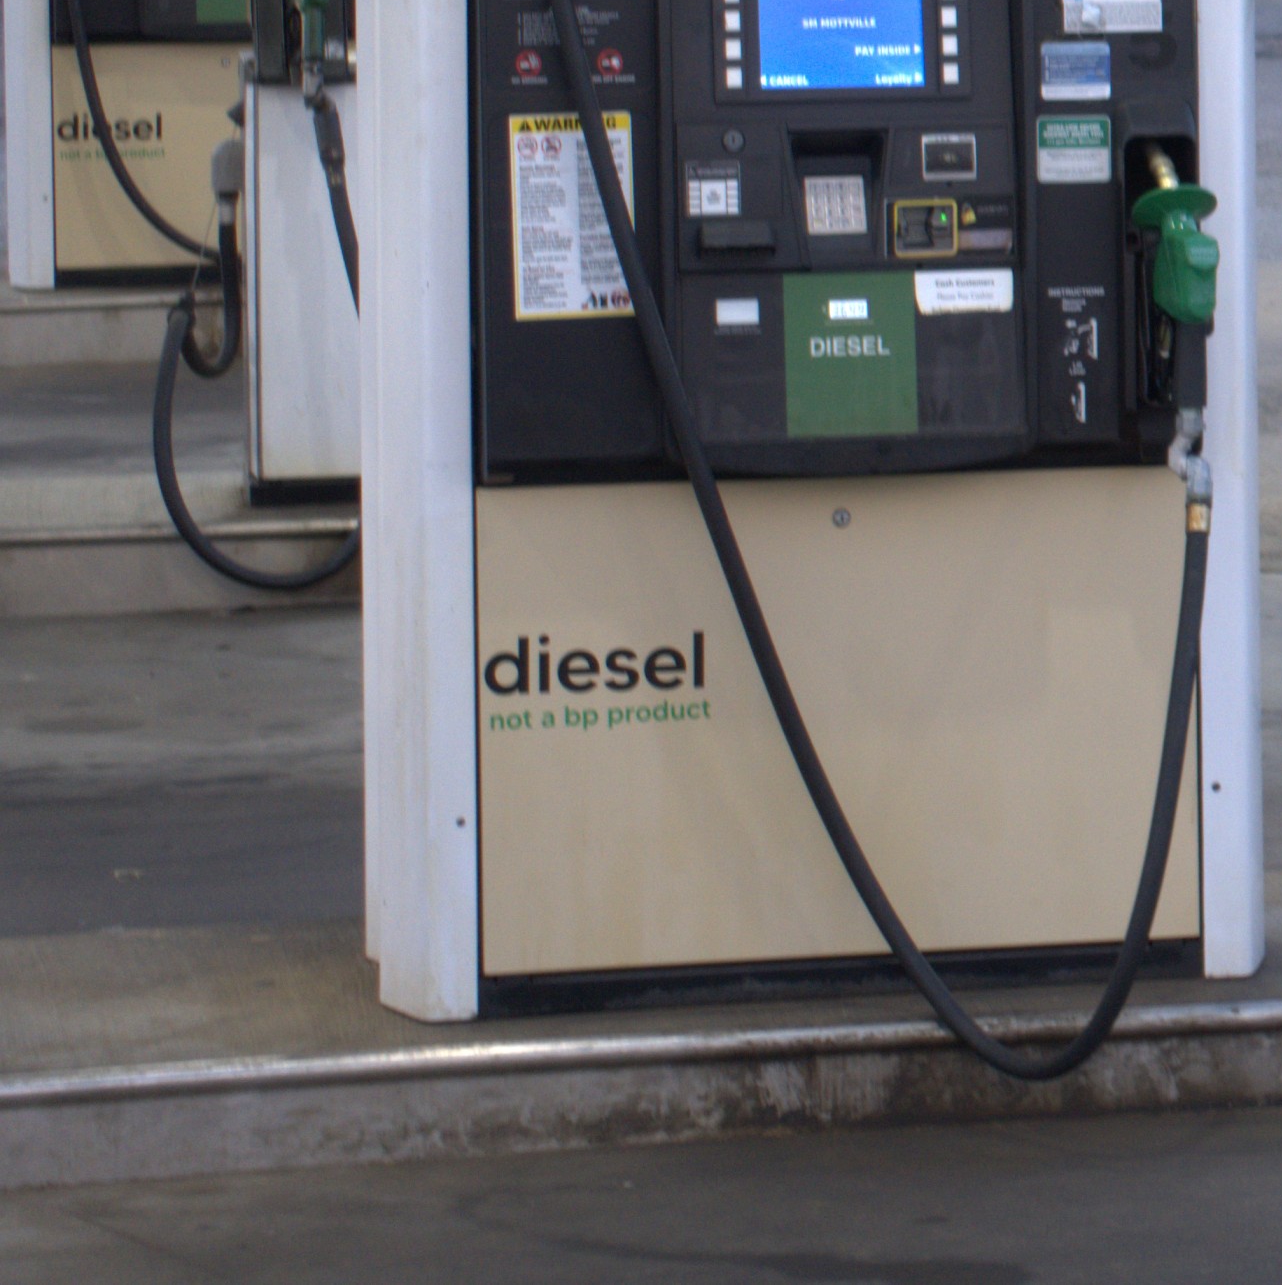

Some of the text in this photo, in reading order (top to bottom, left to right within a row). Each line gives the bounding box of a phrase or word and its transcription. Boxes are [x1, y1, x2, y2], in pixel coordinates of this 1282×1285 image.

[821, 16, 876, 30] MOTTVILLE
[855, 44, 910, 56] PAY INSIDE
[770, 74, 808, 87] CANCEL
[810, 335, 890, 357] DIESEL
[485, 630, 704, 695] diesel
[490, 699, 711, 730] not a bp product
